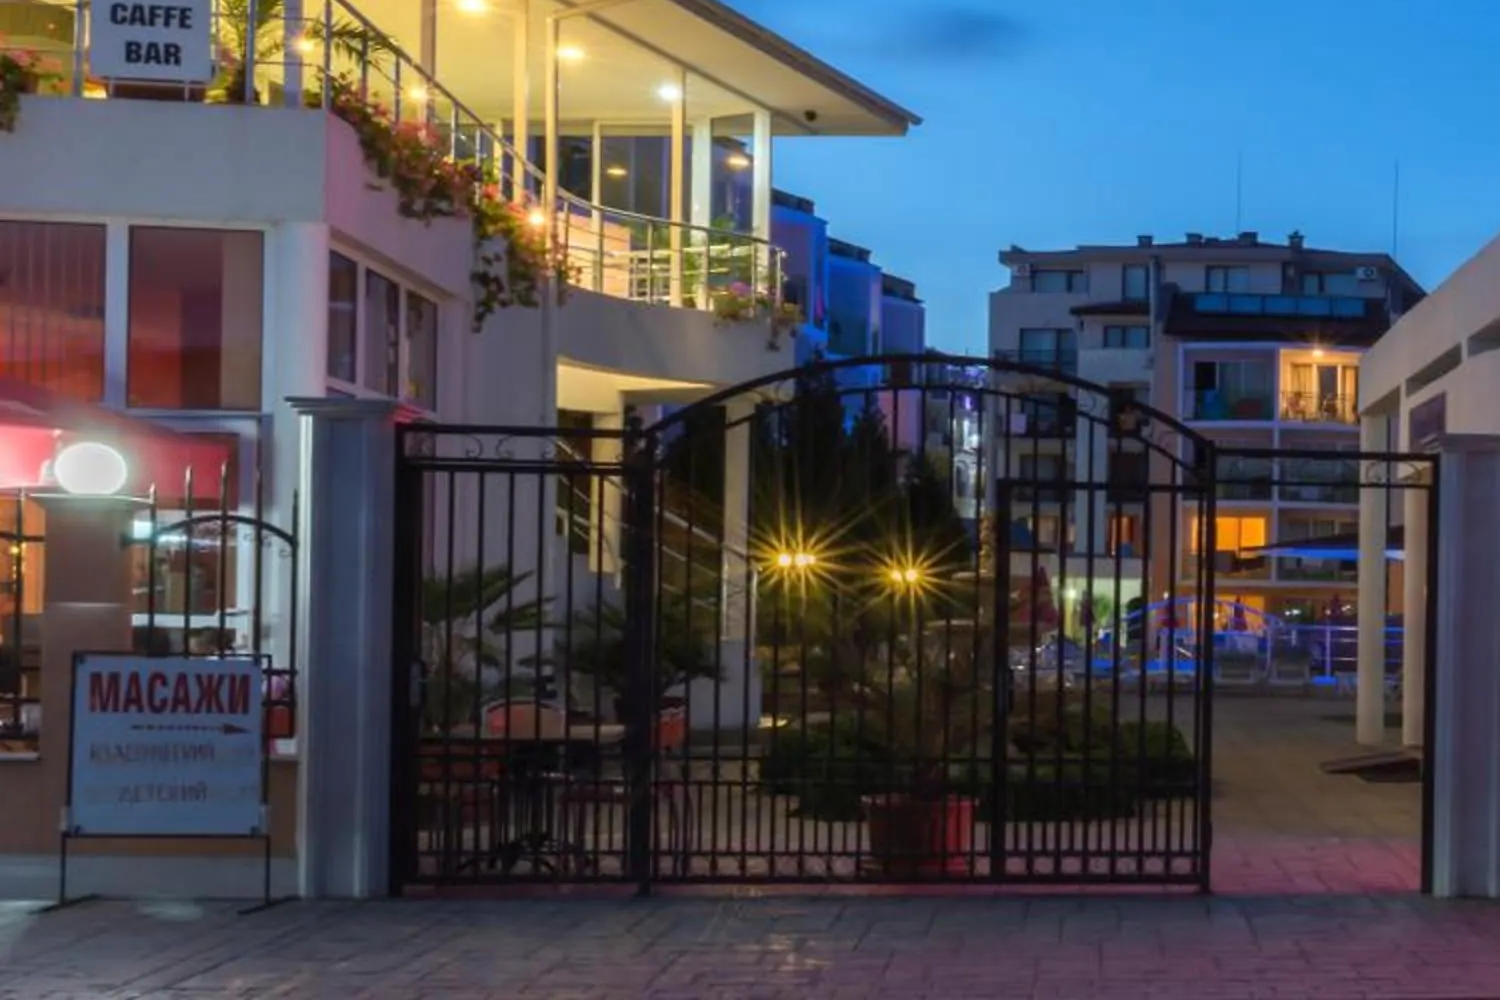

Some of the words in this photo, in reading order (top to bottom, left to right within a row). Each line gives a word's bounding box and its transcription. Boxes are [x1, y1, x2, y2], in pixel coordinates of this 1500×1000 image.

[110, 2, 193, 29] CAFFE
[124, 40, 182, 67] BAR
[88, 671, 252, 715] МАСАЖИ
